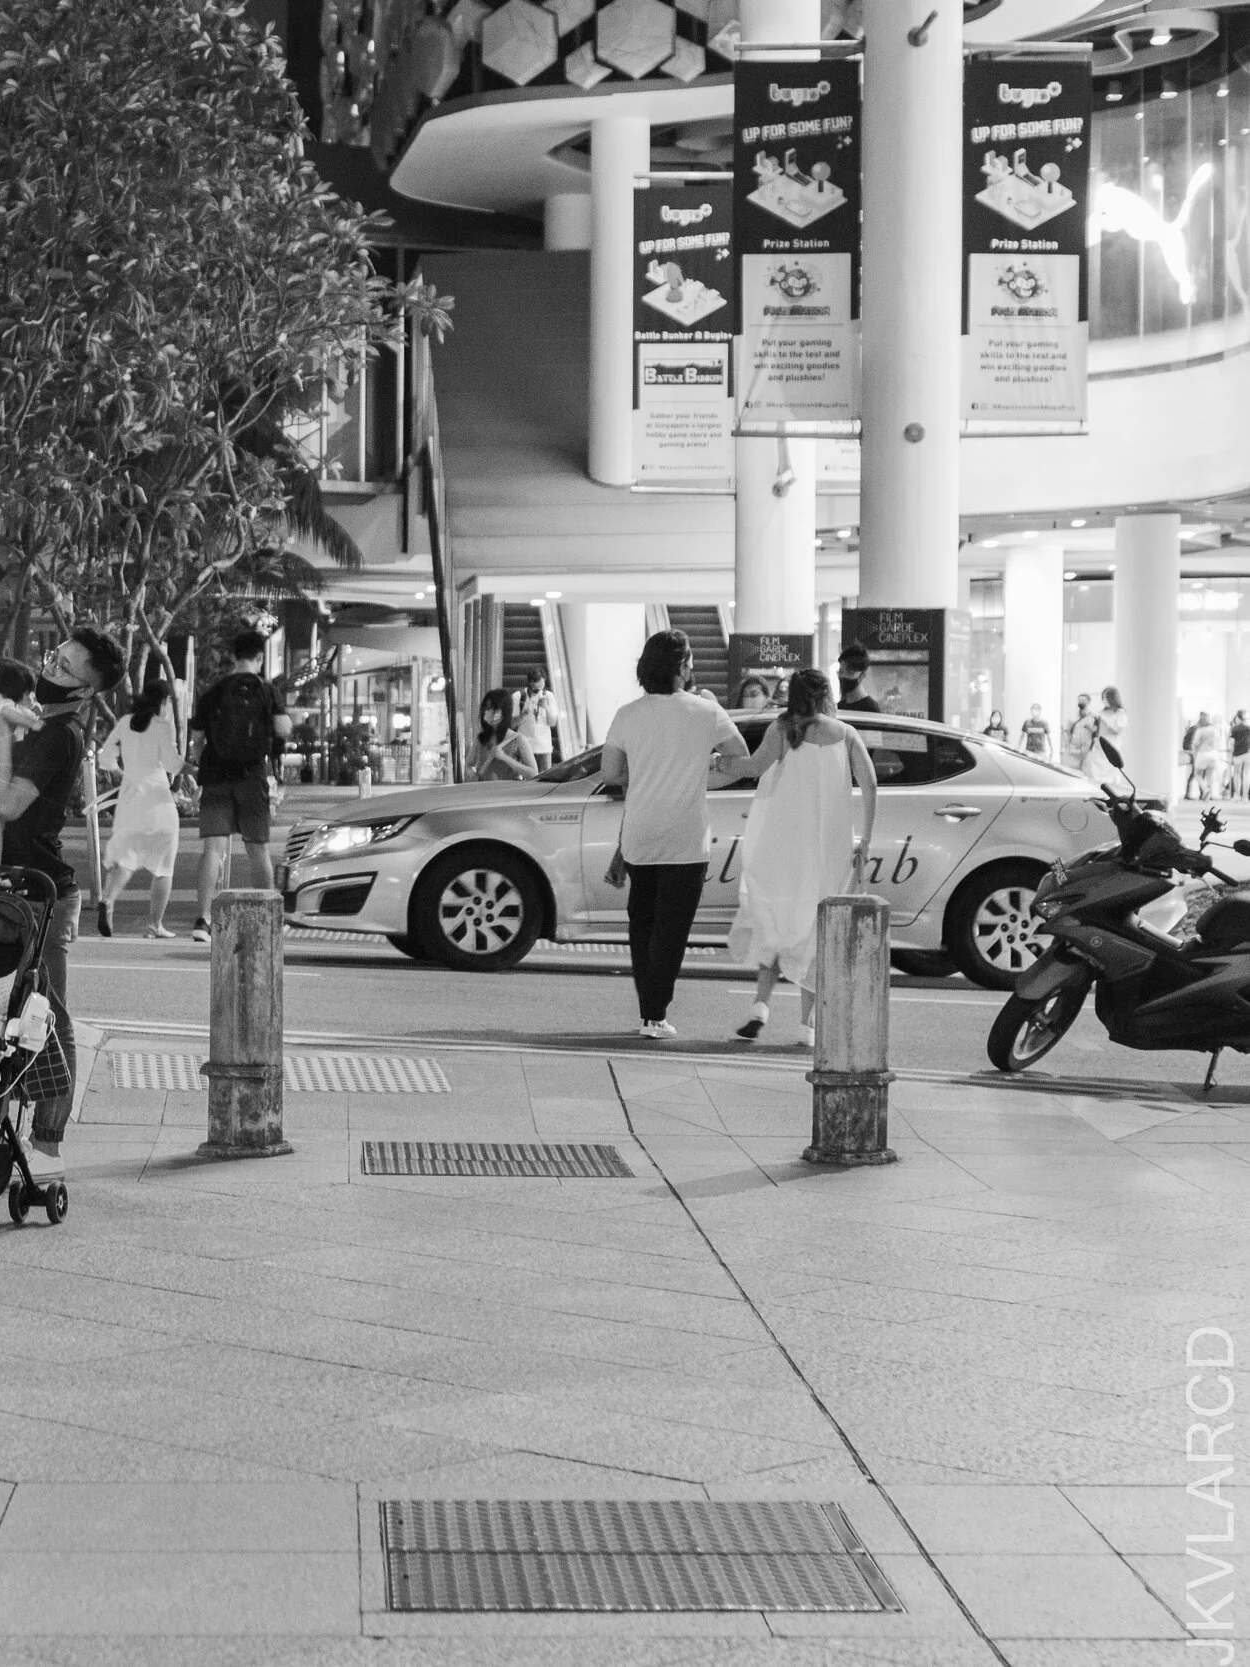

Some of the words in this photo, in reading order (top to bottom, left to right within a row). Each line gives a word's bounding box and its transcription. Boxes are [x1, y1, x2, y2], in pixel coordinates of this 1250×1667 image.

[742, 126, 760, 144] UP
[762, 123, 786, 141] FOR
[787, 119, 821, 137] SOME
[822, 115, 853, 134] FUN?
[971, 126, 990, 143] UP
[991, 123, 1016, 141] FOR
[1017, 119, 1051, 138] SOME
[1052, 117, 1083, 135] FUN?
[638, 240, 655, 254] UP
[655, 238, 676, 252] FOR
[676, 234, 705, 250] SOME
[705, 232, 730, 247] FUN?
[763, 238, 790, 249] Prize
[792, 238, 830, 249] Station
[990, 238, 1019, 250] Prize
[1020, 238, 1059, 250] Station
[634, 331, 661, 340] Battle
[662, 331, 693, 340] Bunker
[800, 339, 832, 347] gaming
[1027, 341, 1059, 349] gaming
[771, 362, 804, 371] exciting
[806, 362, 840, 371] goodies
[997, 363, 1031, 372] exciting
[1033, 364, 1067, 372] goodies
[768, 373, 784, 381] and
[786, 373, 825, 382] plushies!
[879, 612, 904, 622] FILM
[878, 623, 915, 633] GARDE
[760, 637, 780, 645] FILM
[878, 632, 929, 643] CINEPLEX
[759, 645, 789, 653] GARDE
[759, 653, 801, 662] CINEPLEX
